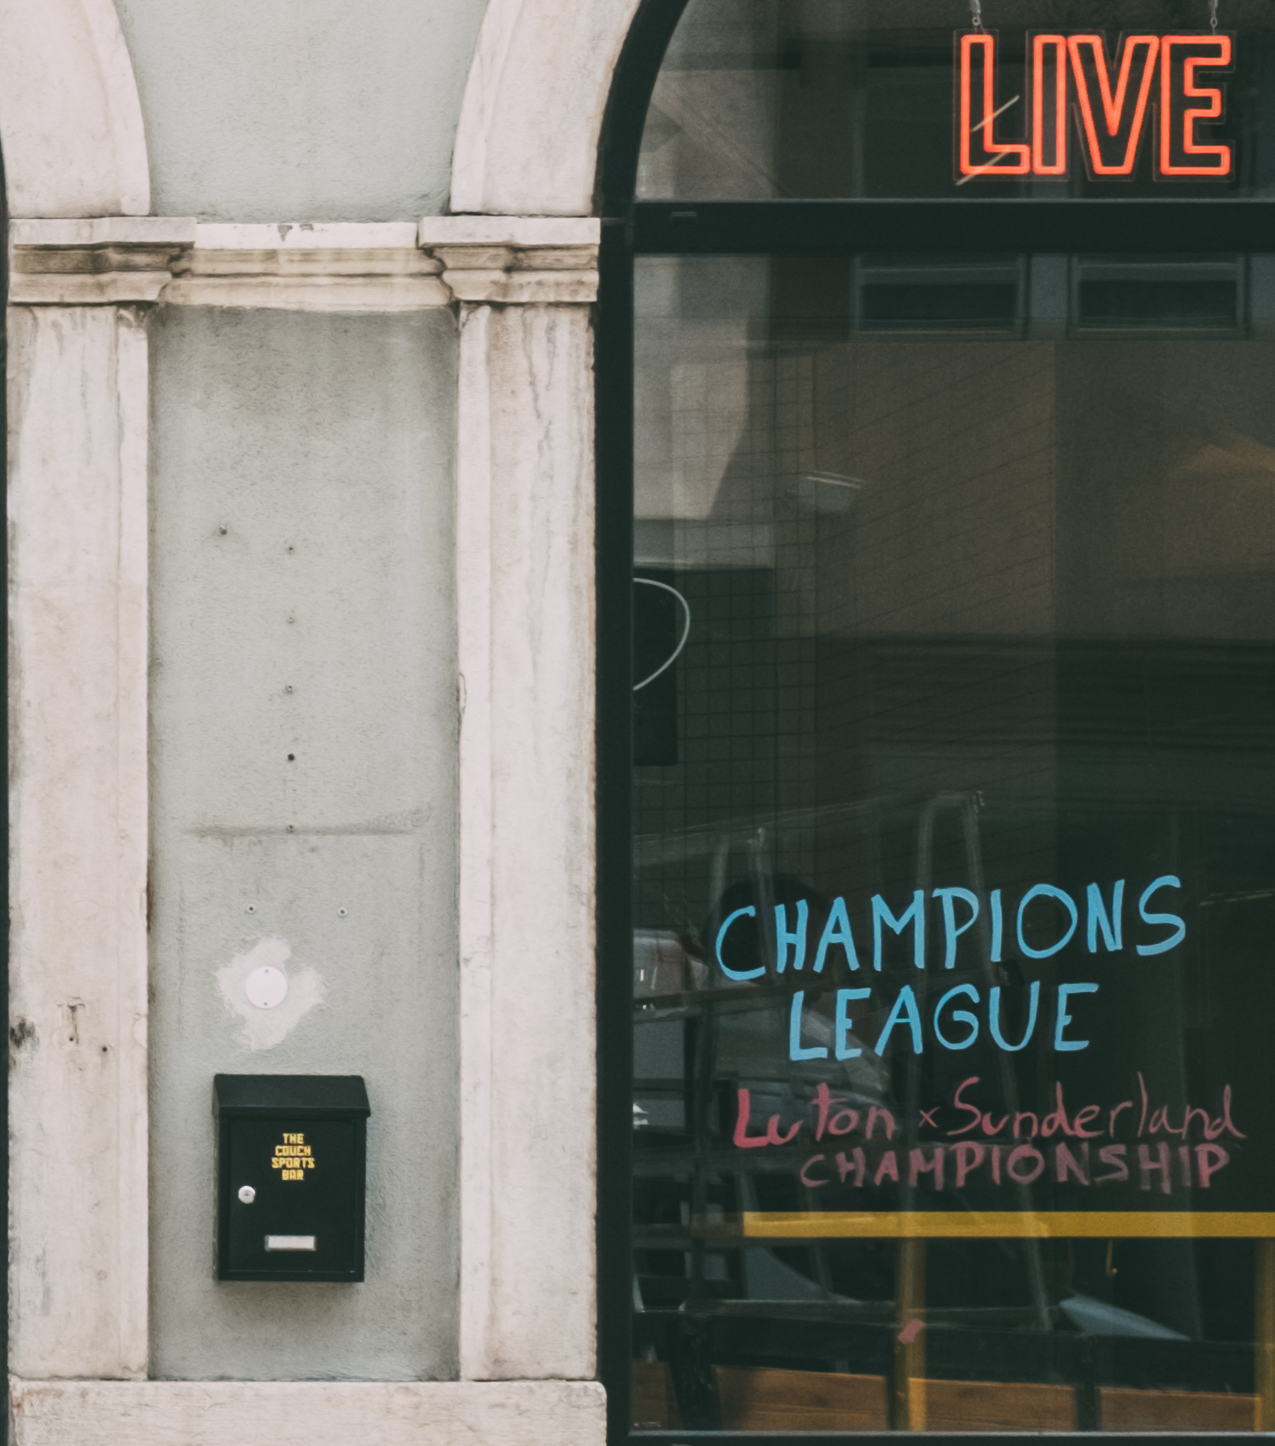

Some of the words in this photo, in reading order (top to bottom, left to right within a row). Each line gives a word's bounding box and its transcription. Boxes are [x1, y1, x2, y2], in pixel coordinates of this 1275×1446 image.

[960, 33, 1232, 175] LIVE
[715, 874, 1187, 981] CHAMPIONS
[788, 980, 1100, 1062] LEAGUE
[732, 1082, 896, 1148] Luton
[947, 1071, 1248, 1140] Sunderland
[271, 1157, 315, 1169] SPORTS
[274, 1145, 312, 1157] COUCH
[282, 1133, 305, 1145] THE
[281, 1169, 305, 1181] BAR
[799, 1140, 1231, 1194] CHAMPIONSHIP
